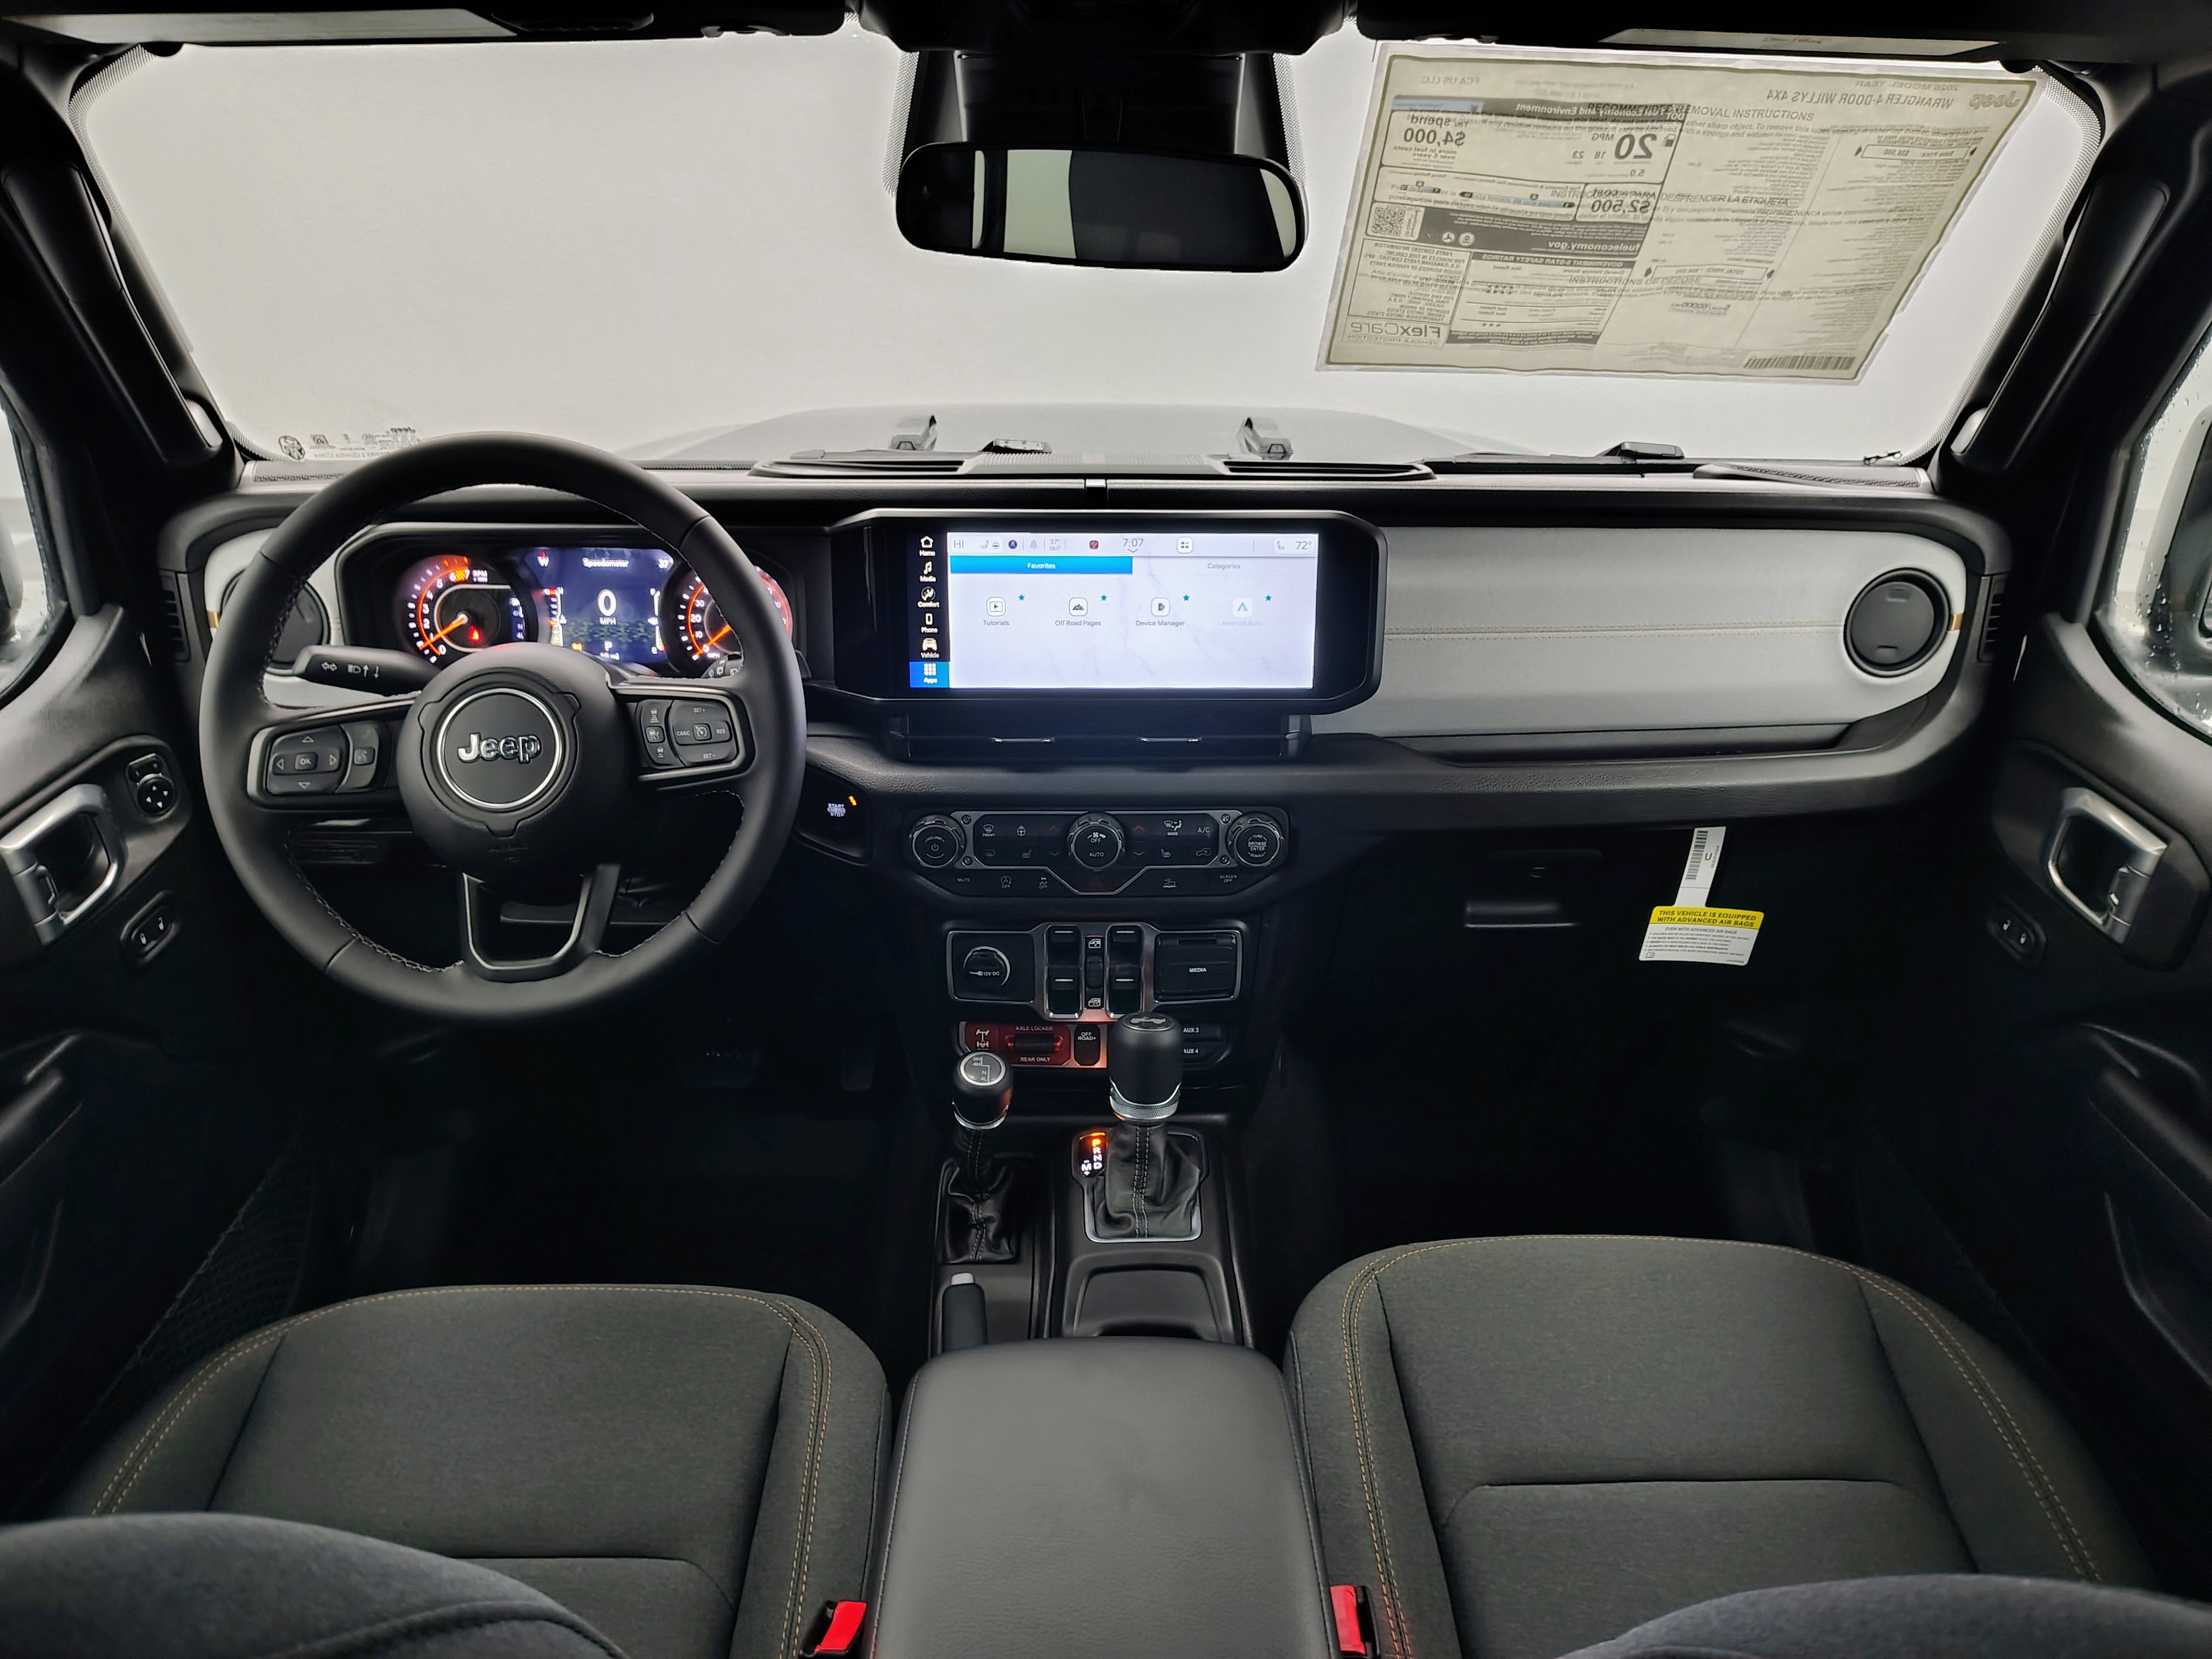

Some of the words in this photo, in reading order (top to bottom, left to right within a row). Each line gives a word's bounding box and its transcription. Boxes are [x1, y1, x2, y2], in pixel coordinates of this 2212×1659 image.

[1732, 109, 1815, 122] INSTRUCTIONS
[1707, 122, 1728, 130] sharp
[1702, 131, 1729, 139] sponge
[1661, 193, 1726, 203] DESPRENDER
[1728, 194, 1740, 203] LA
[1742, 196, 1788, 205] ETIQUETA
[954, 539, 964, 549] HI
[1122, 538, 1144, 547] 7:07
[1295, 541, 1312, 550] 72°
[537, 556, 549, 567] W
[582, 557, 629, 569] Speedometer
[449, 572, 456, 582] 6
[464, 569, 470, 580] 7
[598, 589, 617, 616] 0
[599, 617, 617, 625] MPH
[690, 614, 702, 623] 20
[423, 618, 430, 629] 2
[439, 644, 447, 656] 0
[604, 640, 613, 652] P
[457, 732, 543, 765] Jeep
[300, 757, 312, 765] OK
[1718, 913, 1757, 921] EQUIPPED
[1092, 1138, 1102, 1147] P
[1093, 1154, 1102, 1162] N
[1081, 1163, 1092, 1171] M
[1093, 1162, 1102, 1170] D
